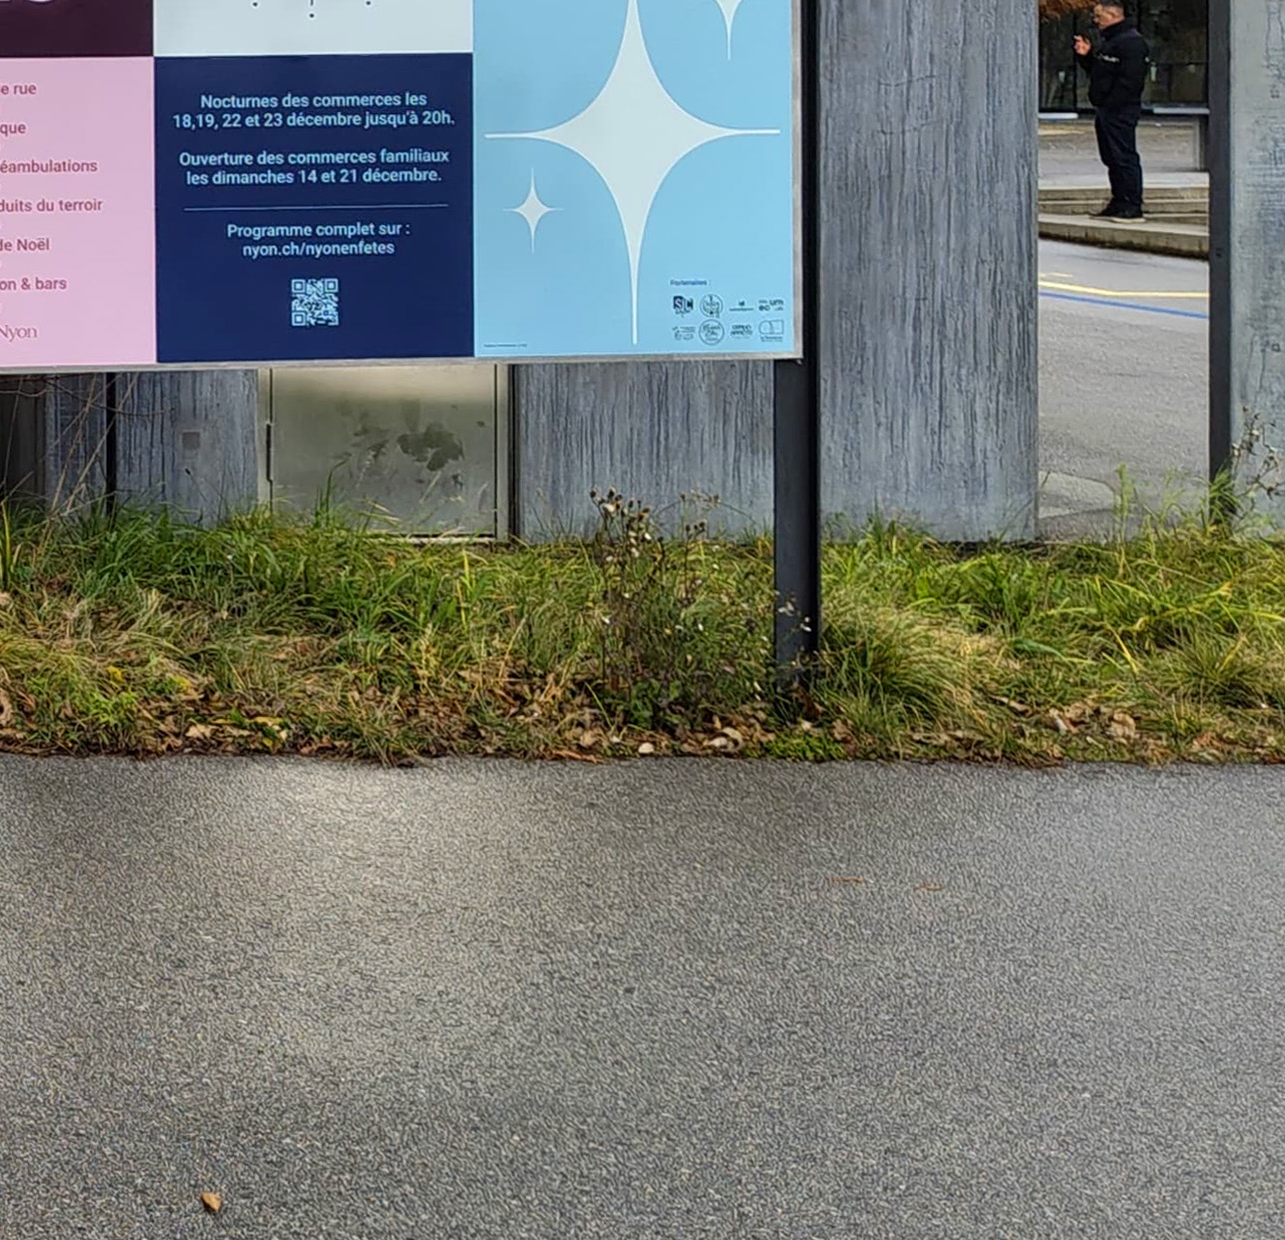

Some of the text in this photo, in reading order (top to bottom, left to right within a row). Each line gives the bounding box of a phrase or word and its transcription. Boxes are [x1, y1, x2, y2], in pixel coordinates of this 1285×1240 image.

[14, 85, 36, 94] rue
[201, 92, 427, 108] Nocturnes des commerces les
[223, 114, 241, 127] 22
[245, 114, 260, 126] et
[264, 113, 282, 126] 23
[287, 112, 361, 126] décembre
[364, 111, 418, 128] jusqu'à
[423, 110, 454, 124] 20h.
[180, 148, 449, 166] Ouverture des commerces familiaux
[187, 168, 441, 184] les dimanches 14 et 21 décembre.
[37, 199, 54, 211] du
[59, 199, 102, 211] terroir
[228, 224, 312, 240] Programme
[316, 222, 375, 238] complet
[379, 225, 402, 235] sur
[17, 238, 49, 251] Noël
[243, 238, 394, 259] nyon.ch/nyonenfetes
[21, 278, 30, 290] &
[36, 277, 66, 289] bars
